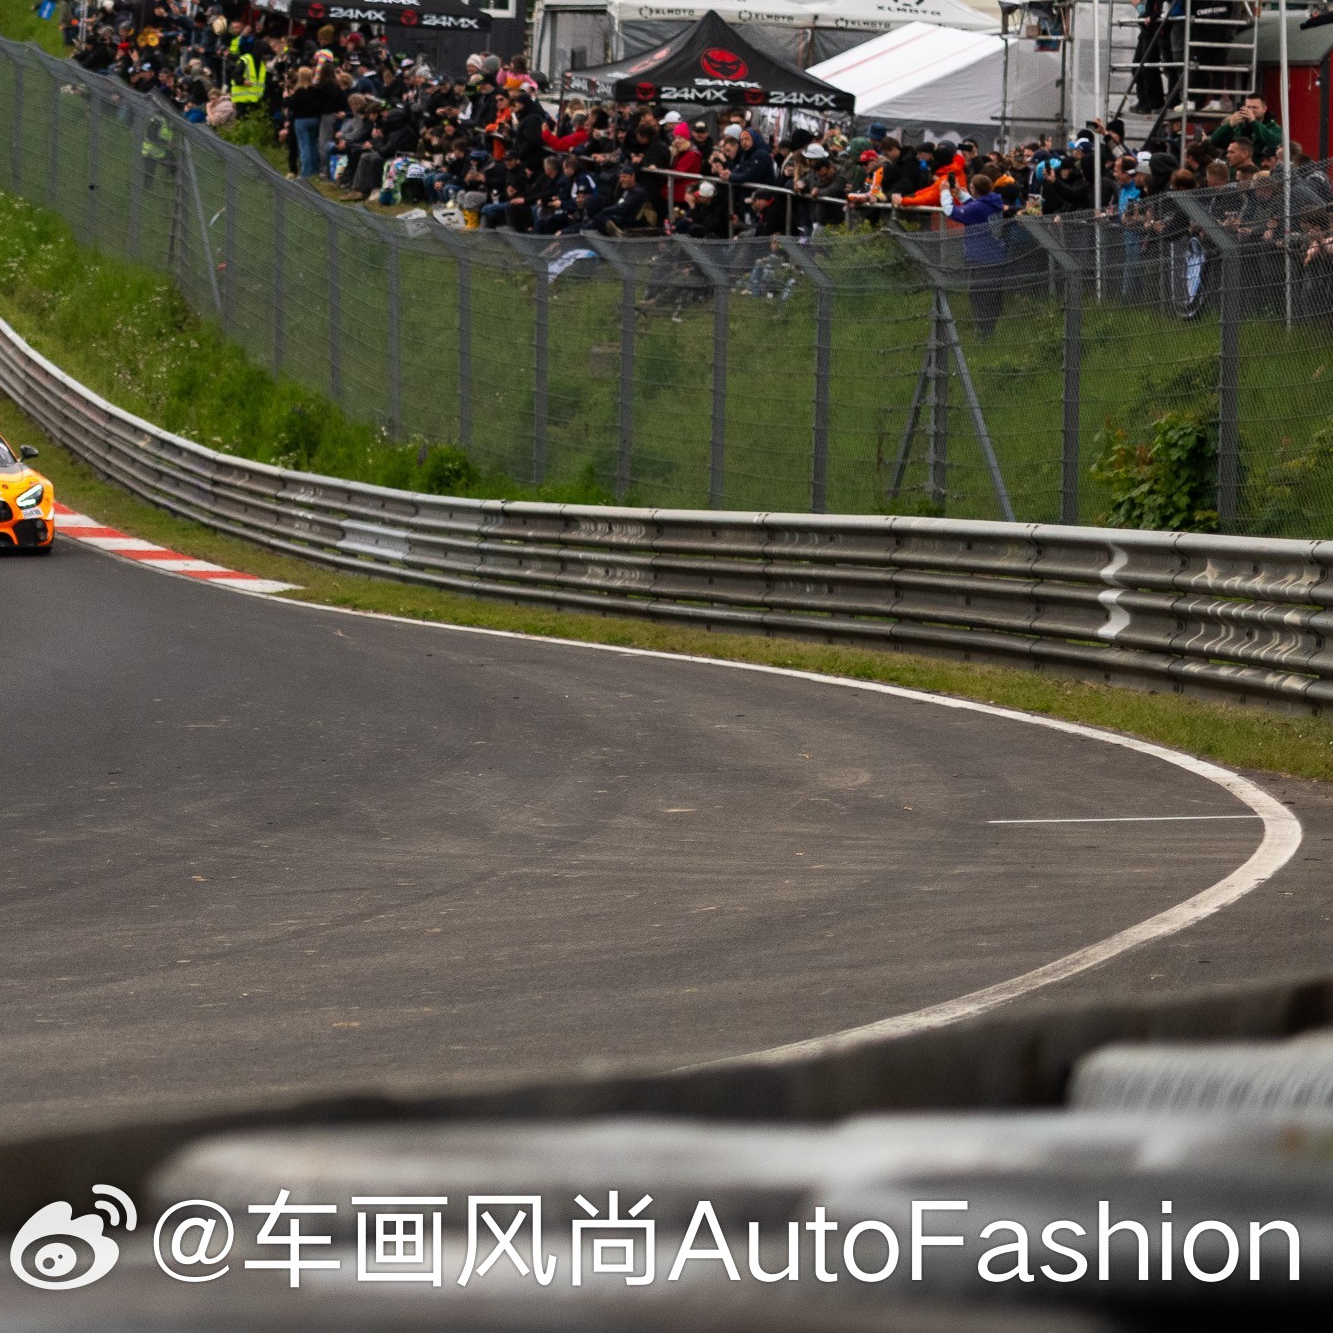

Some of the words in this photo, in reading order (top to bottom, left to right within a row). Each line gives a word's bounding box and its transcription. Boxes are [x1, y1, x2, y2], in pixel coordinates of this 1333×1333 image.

[329, 7, 386, 22] 24MX
[422, 13, 480, 30] 24MX
[660, 86, 729, 103] 24MX
[768, 91, 837, 108] 24MX
